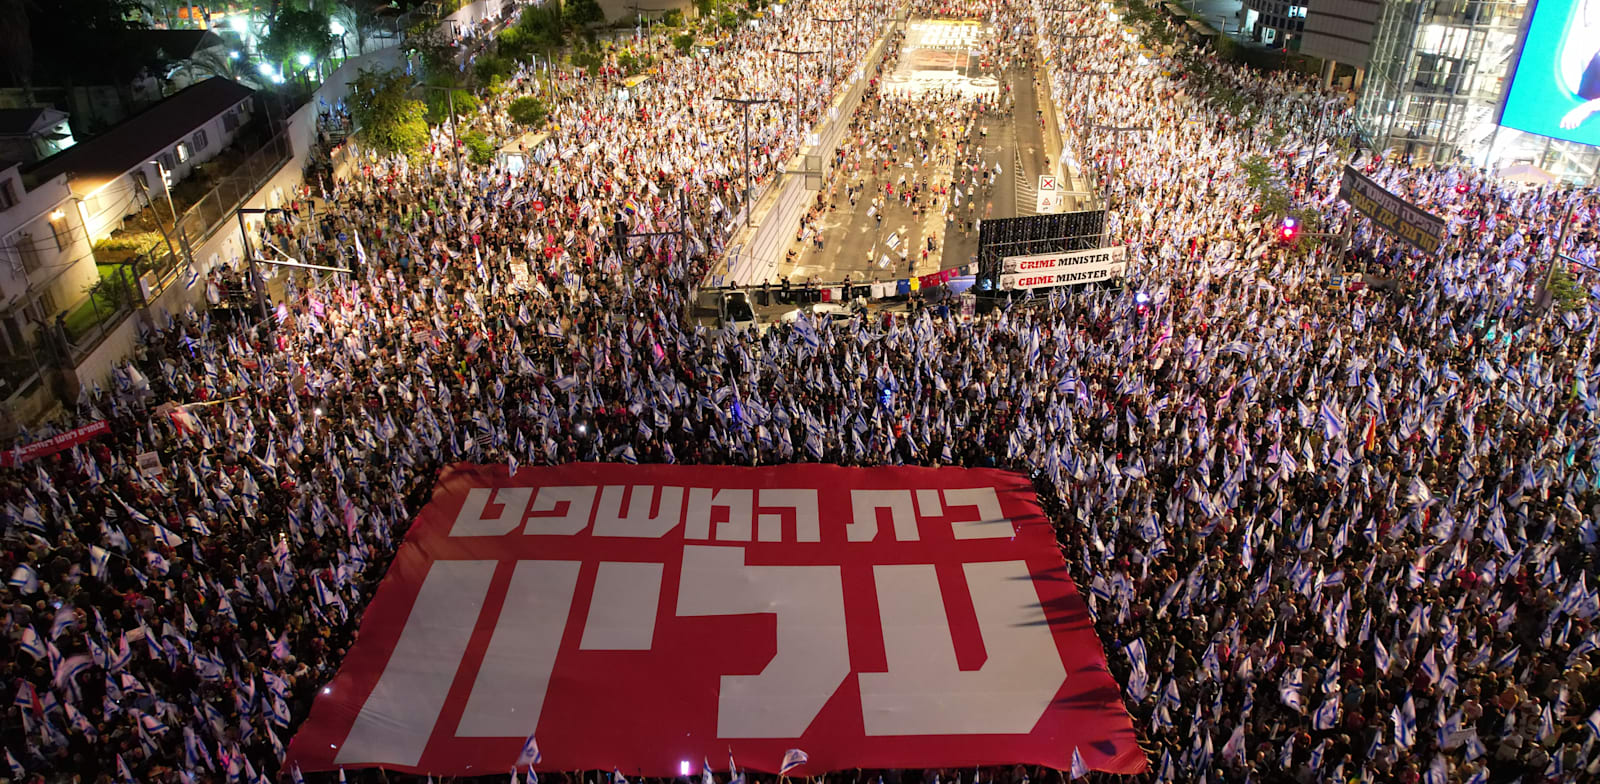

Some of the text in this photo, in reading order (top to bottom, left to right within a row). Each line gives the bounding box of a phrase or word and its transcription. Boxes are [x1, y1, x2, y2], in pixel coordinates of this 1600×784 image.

[1378, 208, 1398, 229] את
[1020, 253, 1109, 270] CRIME MINISTER
[1018, 269, 1107, 287] CRIME MINISTER
[448, 485, 1015, 542] בית המשפט
[333, 545, 1068, 767] עליון
